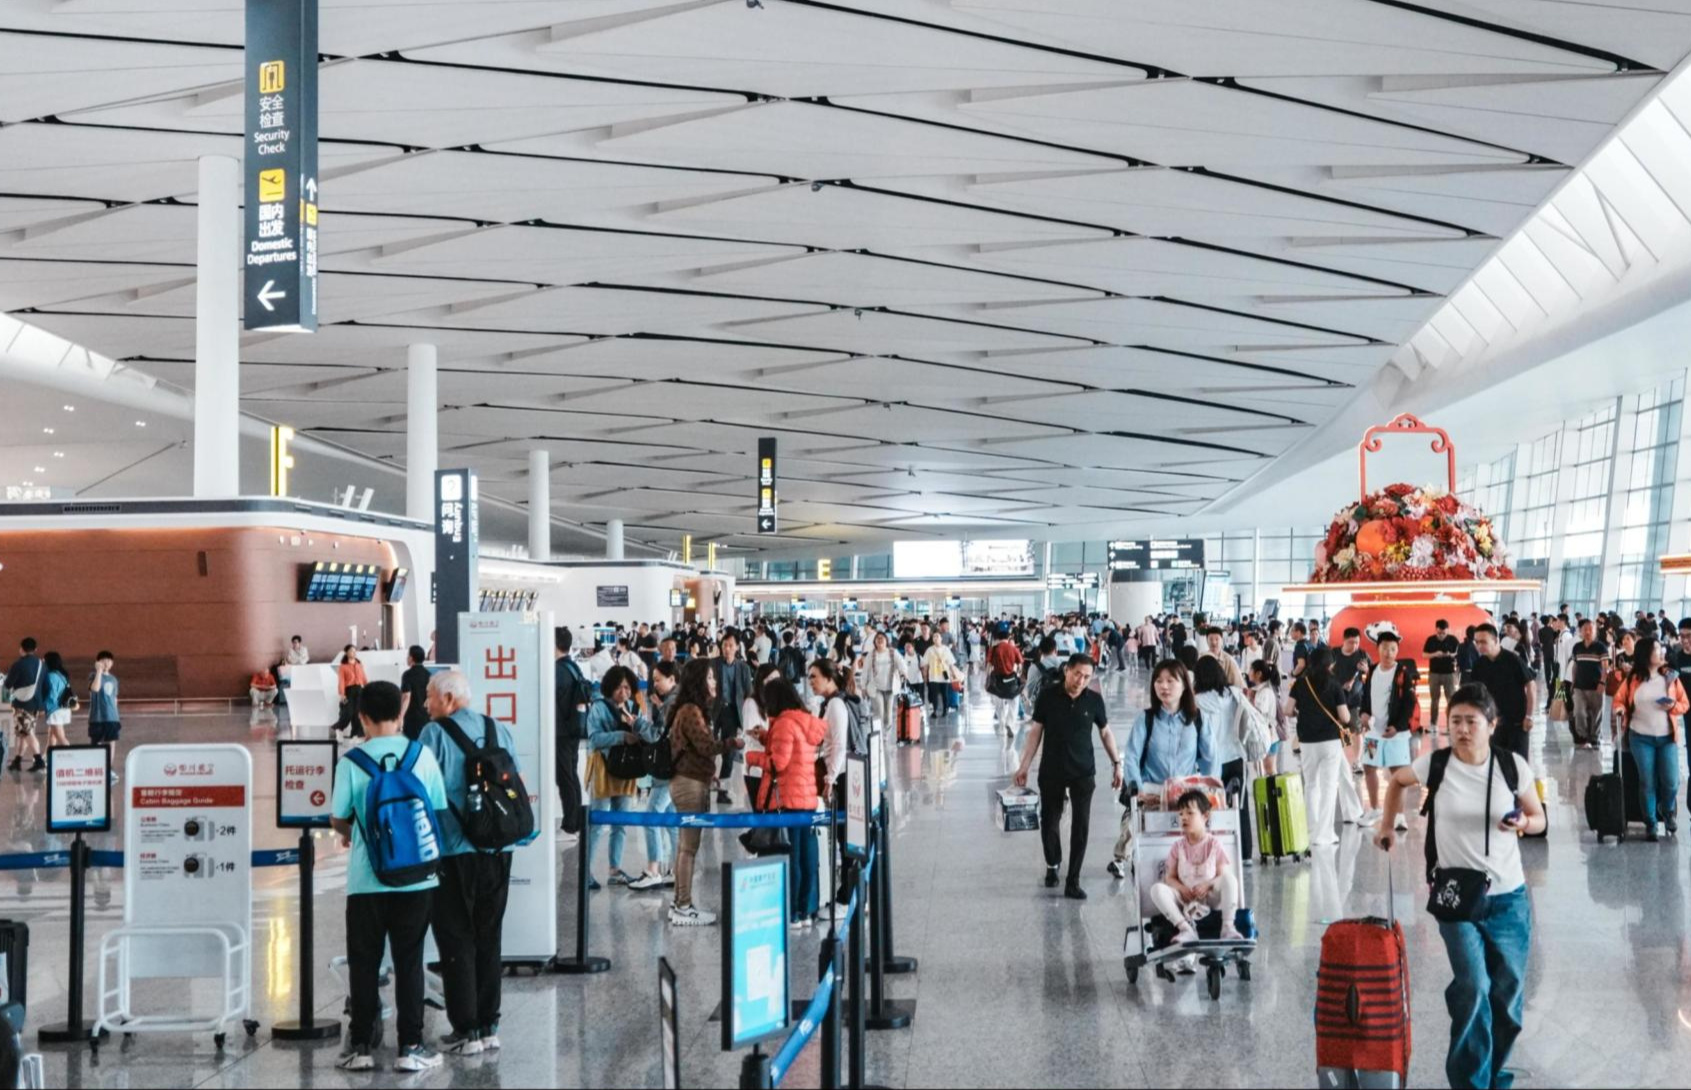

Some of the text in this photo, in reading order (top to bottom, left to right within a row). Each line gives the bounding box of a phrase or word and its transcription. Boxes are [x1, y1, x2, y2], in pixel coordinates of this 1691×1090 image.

[259, 94, 284, 112] 安全
[259, 112, 285, 129] 检查
[254, 129, 290, 143] Security
[258, 142, 285, 155] Check
[259, 203, 284, 221] 国内
[259, 220, 284, 237] 出发
[251, 238, 293, 252] Domestic
[247, 252, 297, 266] Departures
[452, 502, 463, 543] Enquiry
[817, 558, 831, 580] E
[485, 645, 516, 724] 出口
[285, 765, 325, 776] 托运行李
[162, 797, 191, 806] Baggage
[193, 796, 214, 804] Guide
